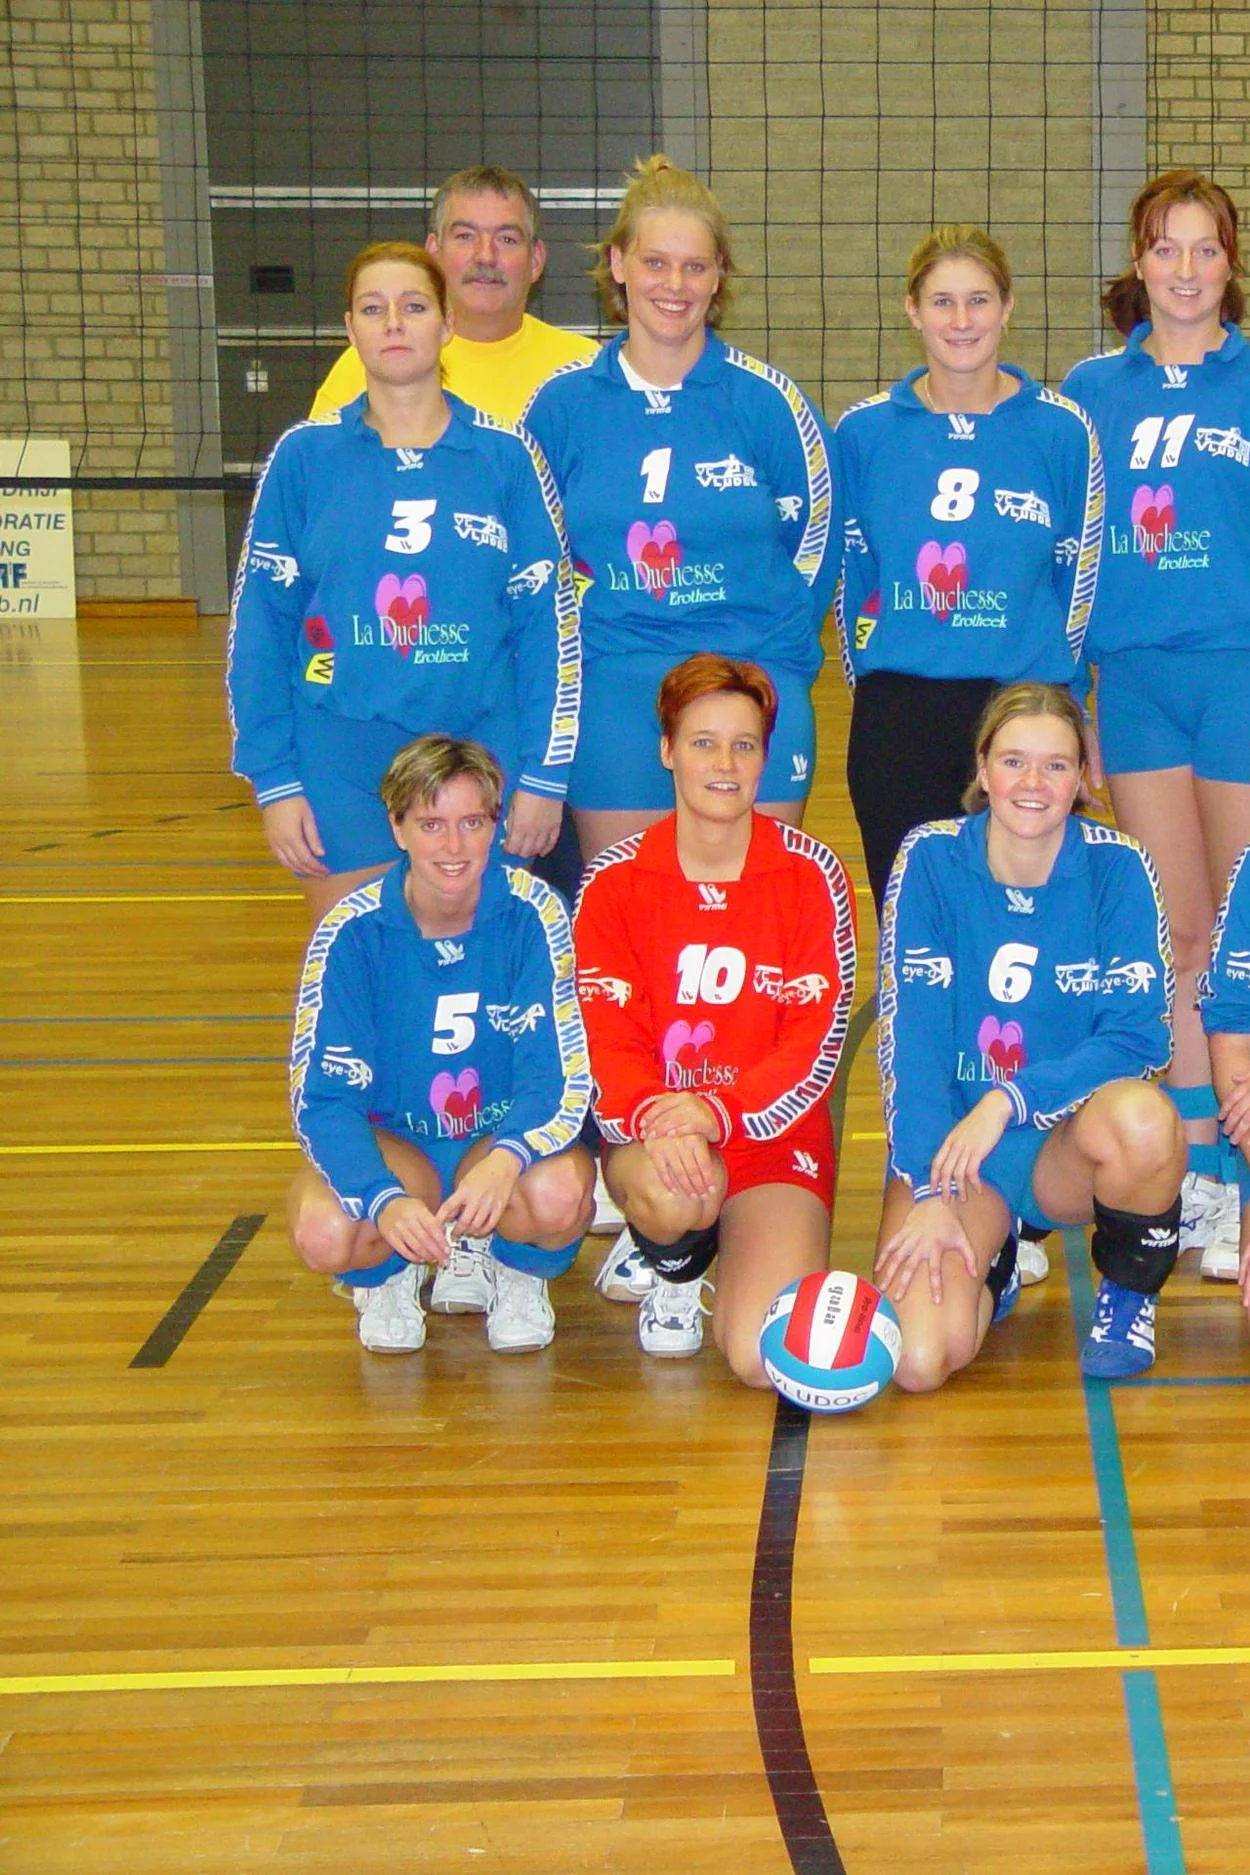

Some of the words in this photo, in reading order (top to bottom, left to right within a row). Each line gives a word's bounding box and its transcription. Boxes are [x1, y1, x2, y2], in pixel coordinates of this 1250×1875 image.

[1130, 414, 1196, 470] 11
[640, 447, 672, 503] 1
[930, 468, 980, 521] 8
[0, 513, 66, 530] RATIE
[384, 499, 437, 554] 3
[1110, 525, 1128, 555] La
[1133, 523, 1211, 554] Duchesse
[607, 563, 630, 591] La
[632, 557, 725, 591] Duchesse
[893, 582, 913, 611] La
[920, 582, 1008, 612] Duchesse
[352, 614, 375, 646] La
[379, 614, 470, 646] Duchesse
[676, 944, 746, 1005] 10
[988, 942, 1039, 1003] 6
[431, 992, 480, 1055] 5
[957, 1052, 975, 1081] La
[436, 1098, 515, 1138] Duchess
[770, 1371, 870, 1407] VLUDOC
